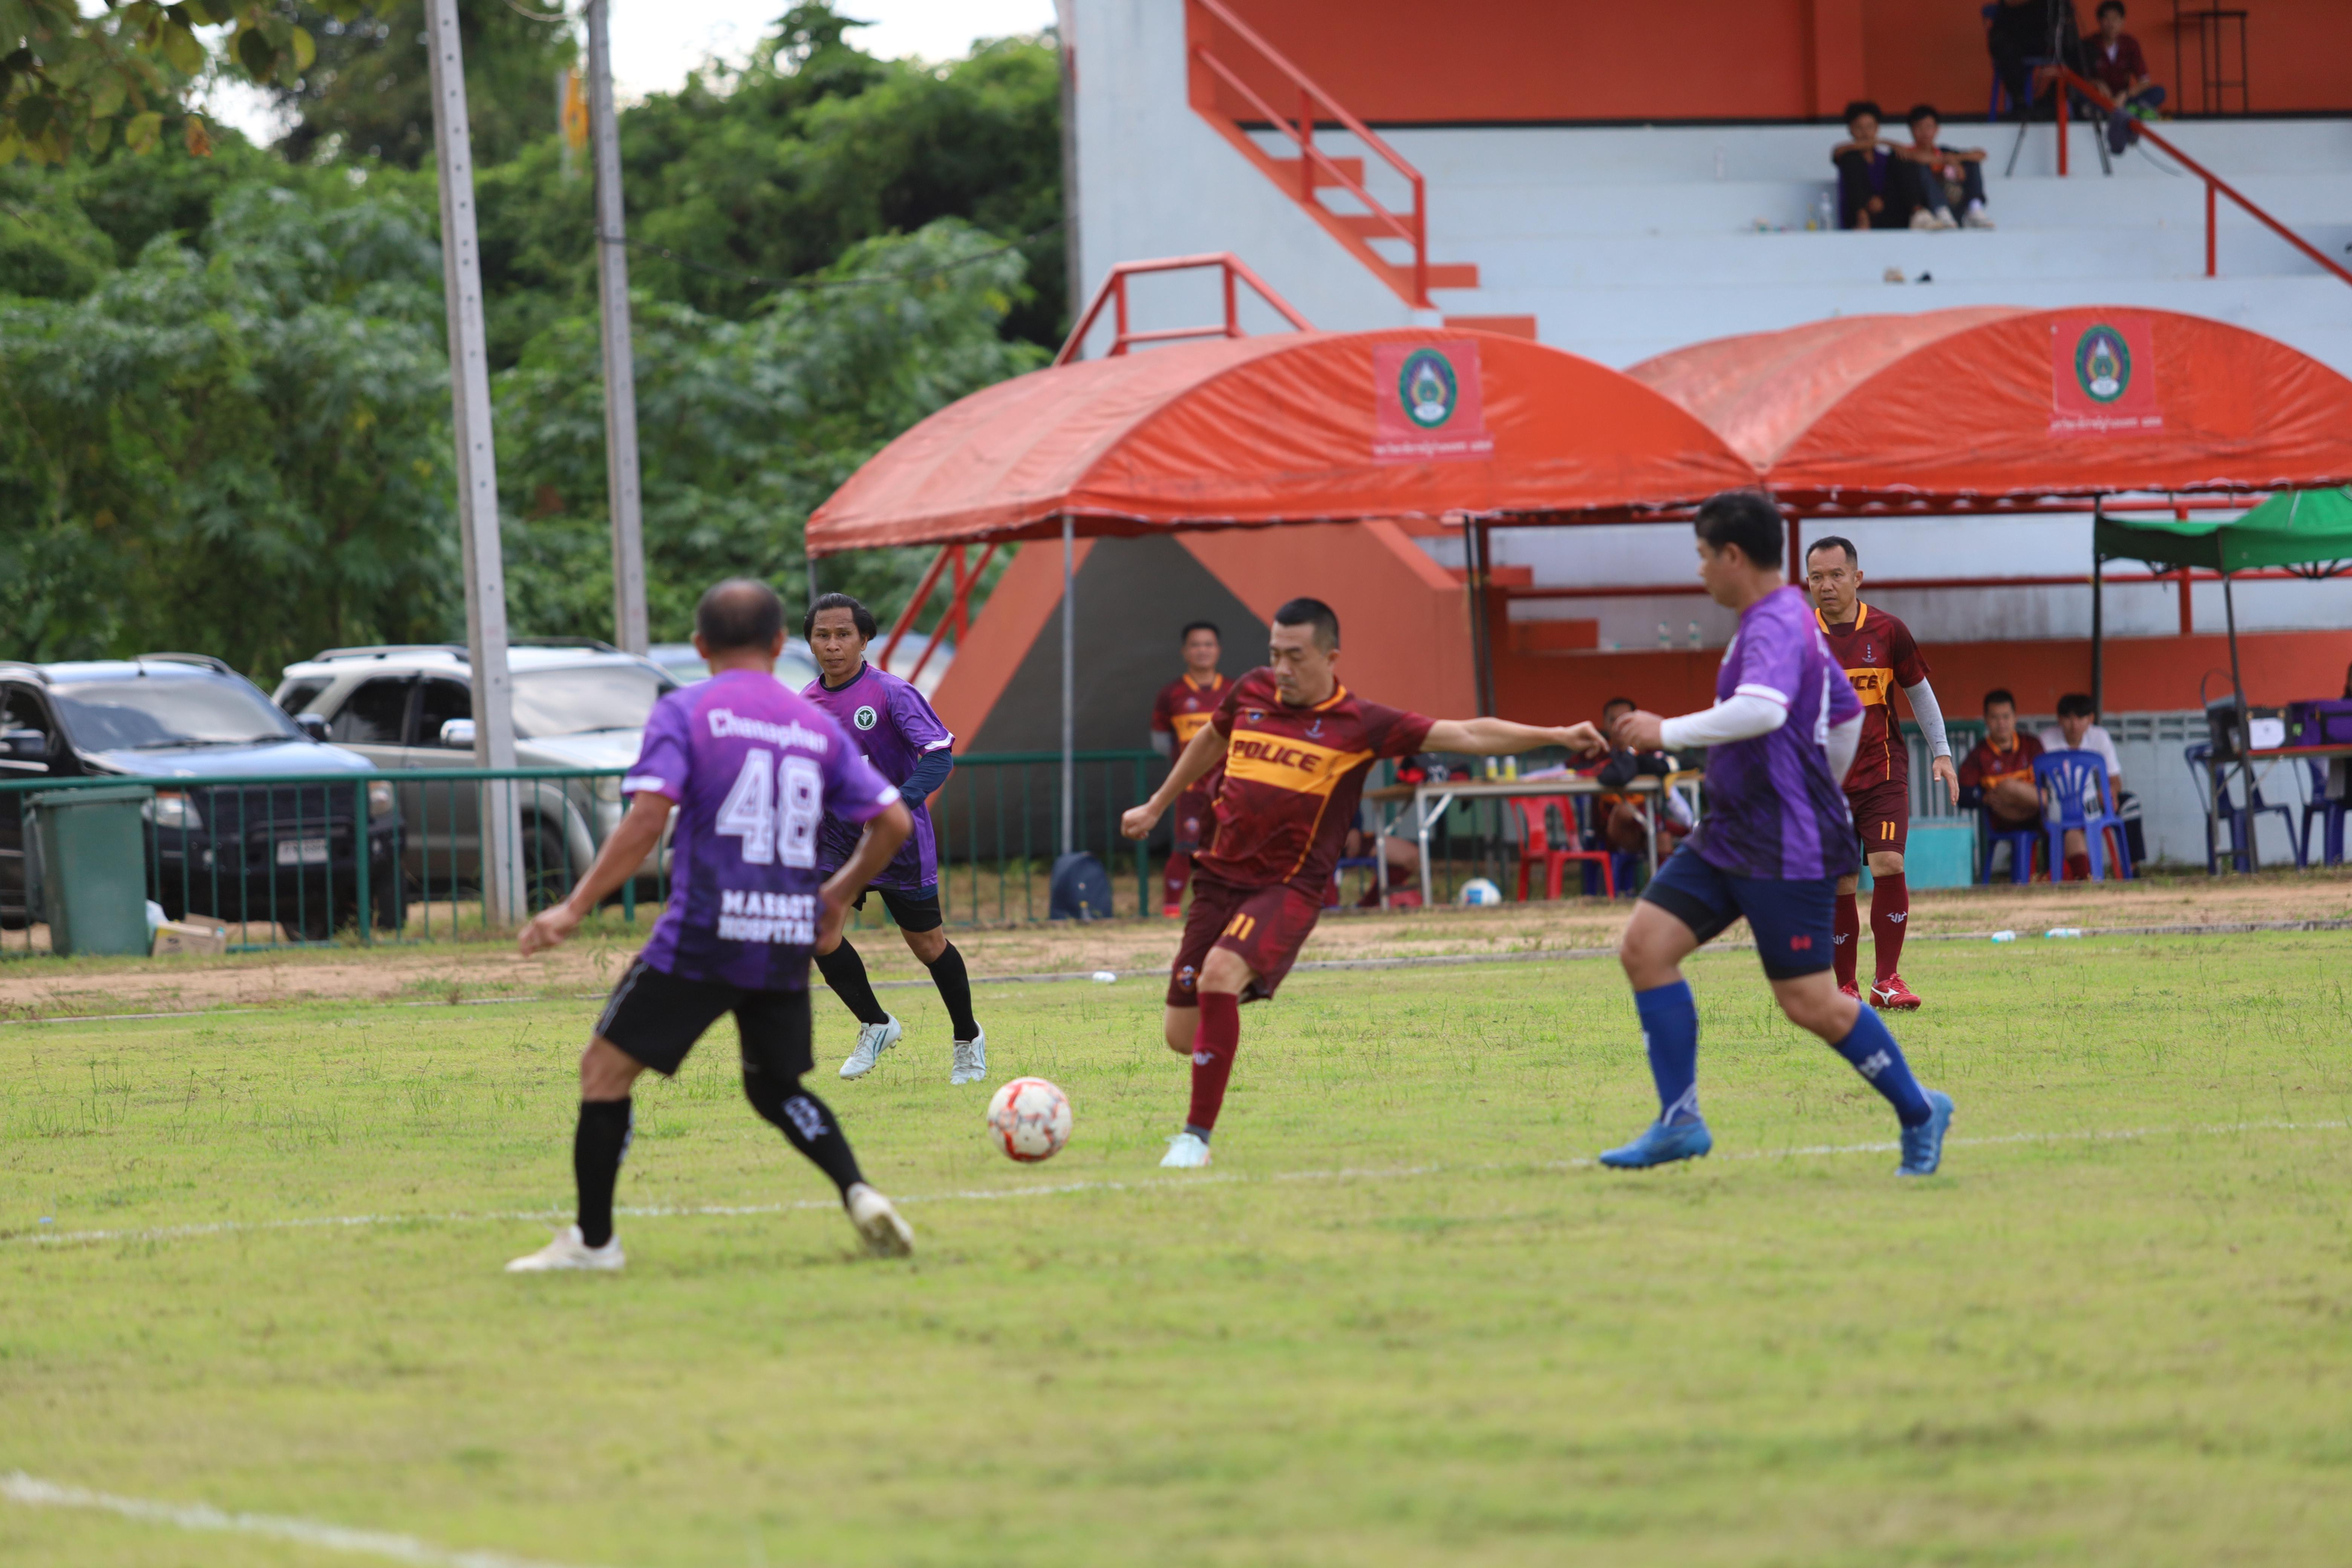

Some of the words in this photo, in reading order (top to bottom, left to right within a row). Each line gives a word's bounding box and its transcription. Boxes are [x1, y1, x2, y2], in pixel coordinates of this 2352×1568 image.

[1849, 674, 1878, 691] ICE
[1231, 740, 1323, 773] POLICE
[715, 747, 825, 869] 48
[1881, 821, 1896, 841] 11
[721, 889, 816, 920] MAESOT
[717, 916, 816, 944] HOSPITAL
